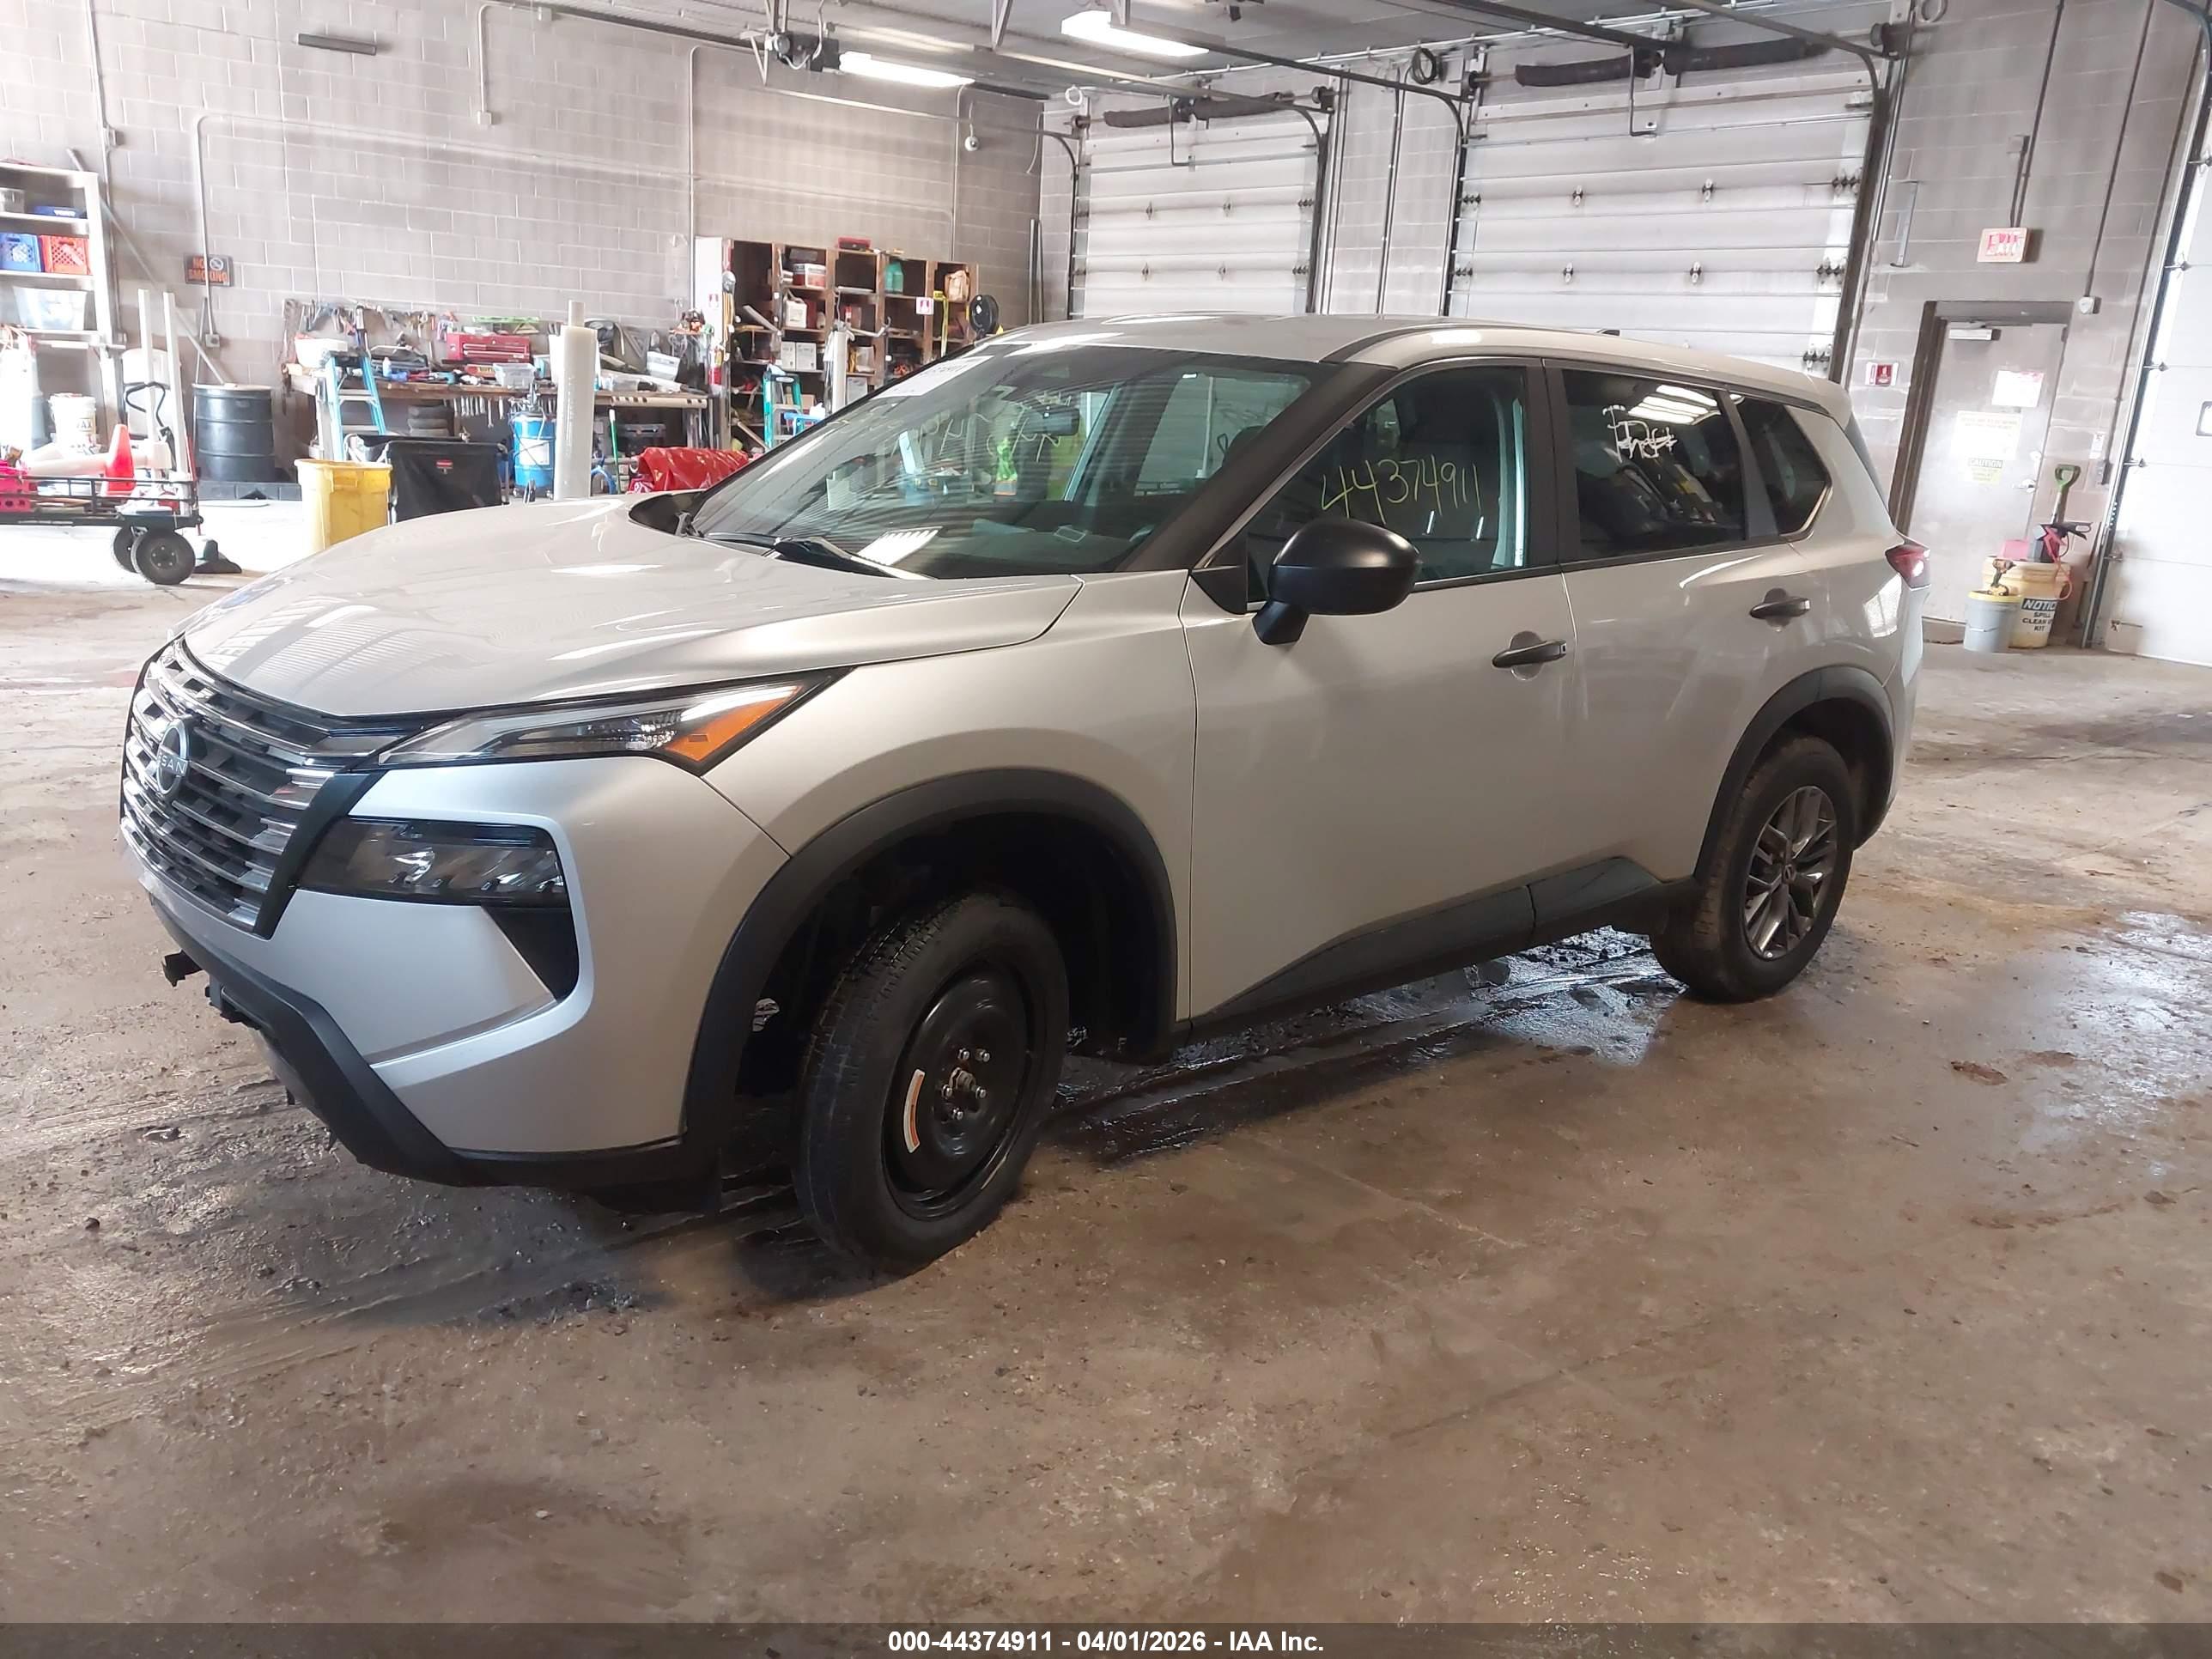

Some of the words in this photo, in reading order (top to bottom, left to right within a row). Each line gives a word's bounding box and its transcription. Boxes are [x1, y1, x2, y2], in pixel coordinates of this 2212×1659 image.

[1985, 233, 2025, 257] EXIT
[1970, 459, 2003, 468] CAUTION
[1321, 453, 1481, 525] 44374911
[2023, 599, 2057, 611] NOTIC
